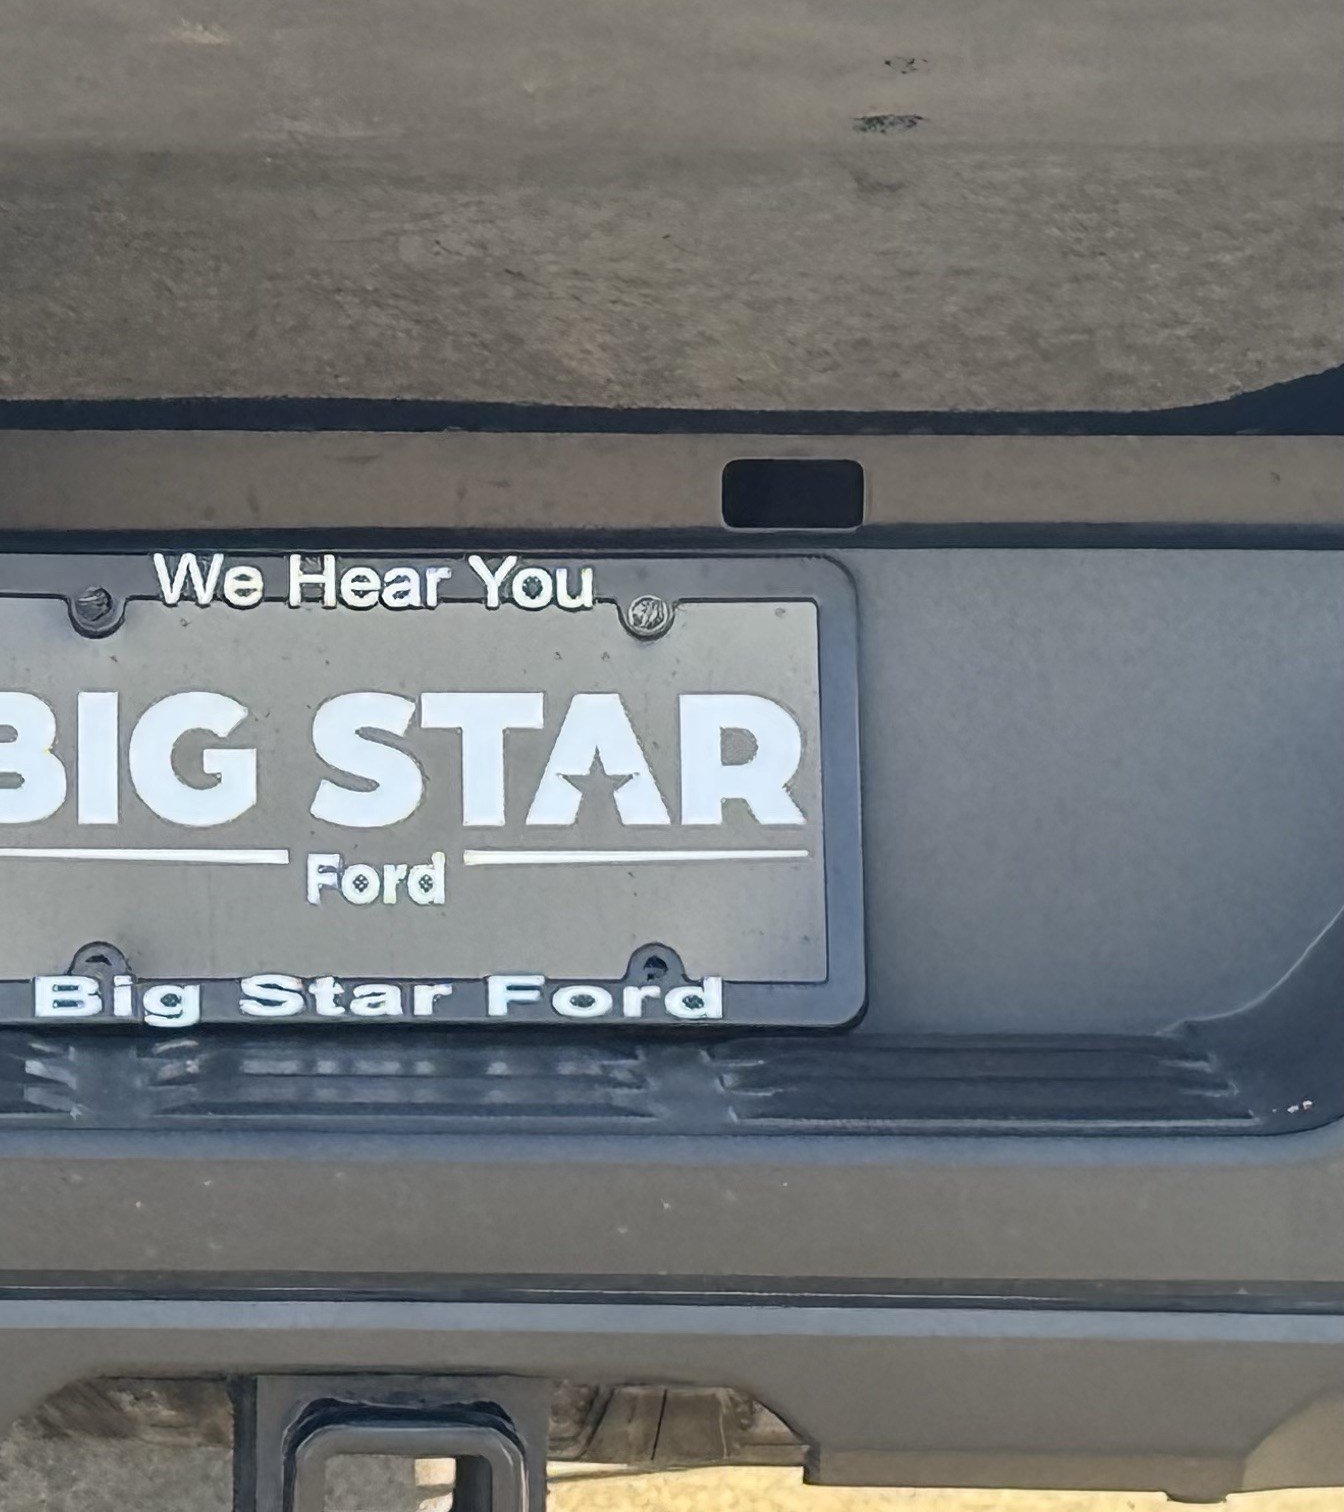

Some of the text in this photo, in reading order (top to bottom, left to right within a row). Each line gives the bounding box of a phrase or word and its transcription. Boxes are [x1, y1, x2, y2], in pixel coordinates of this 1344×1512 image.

[153, 552, 594, 612] We Hear You
[309, 690, 807, 829] STAR
[306, 851, 447, 905] Ford
[33, 973, 724, 1028] Big Star Ford
